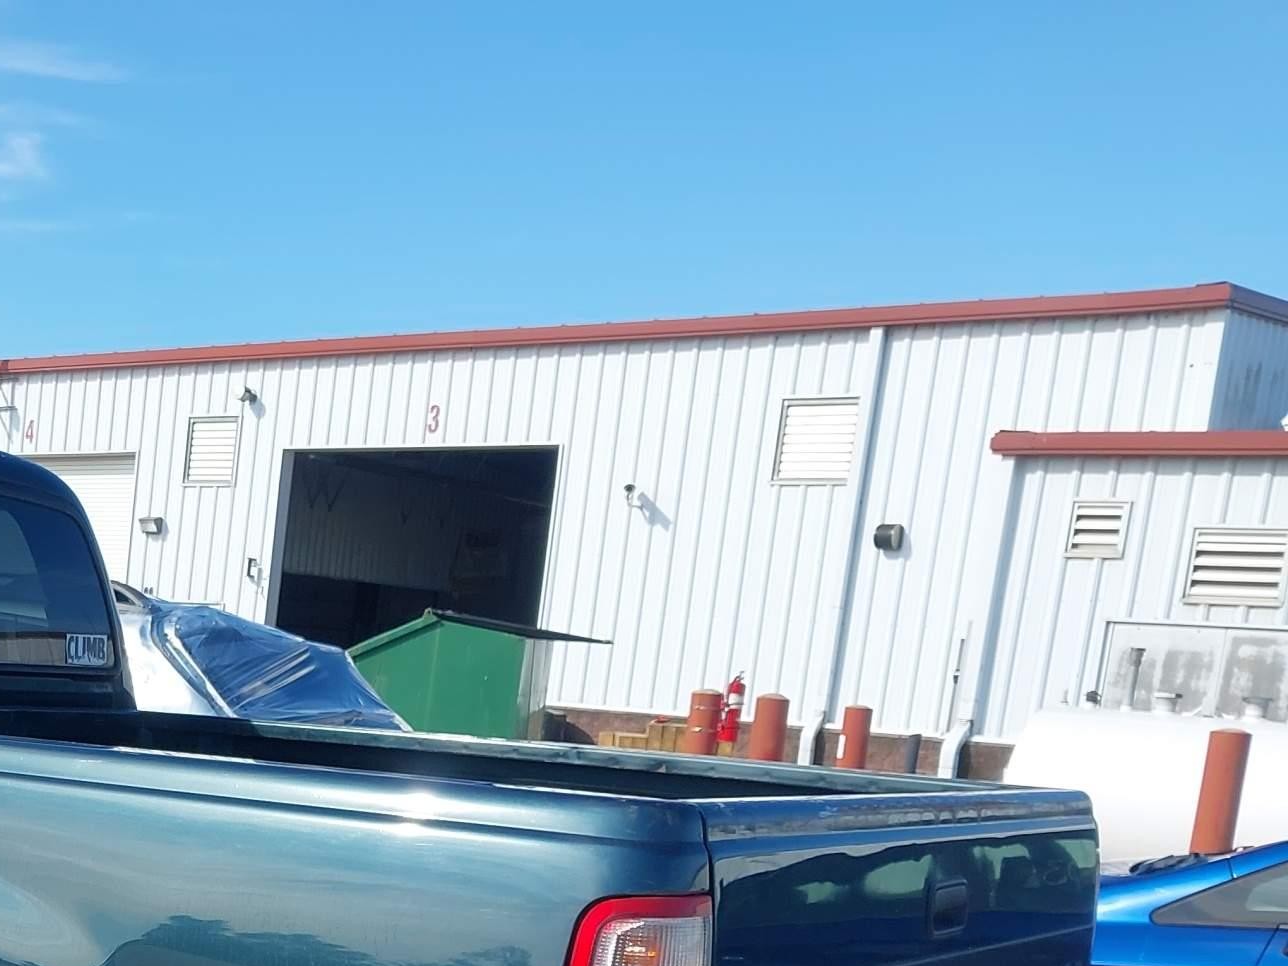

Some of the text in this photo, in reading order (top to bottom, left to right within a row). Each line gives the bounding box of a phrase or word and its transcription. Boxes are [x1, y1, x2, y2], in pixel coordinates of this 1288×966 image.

[25, 420, 34, 444] 4
[428, 405, 440, 433] 3
[67, 635, 106, 663] CLIMB
